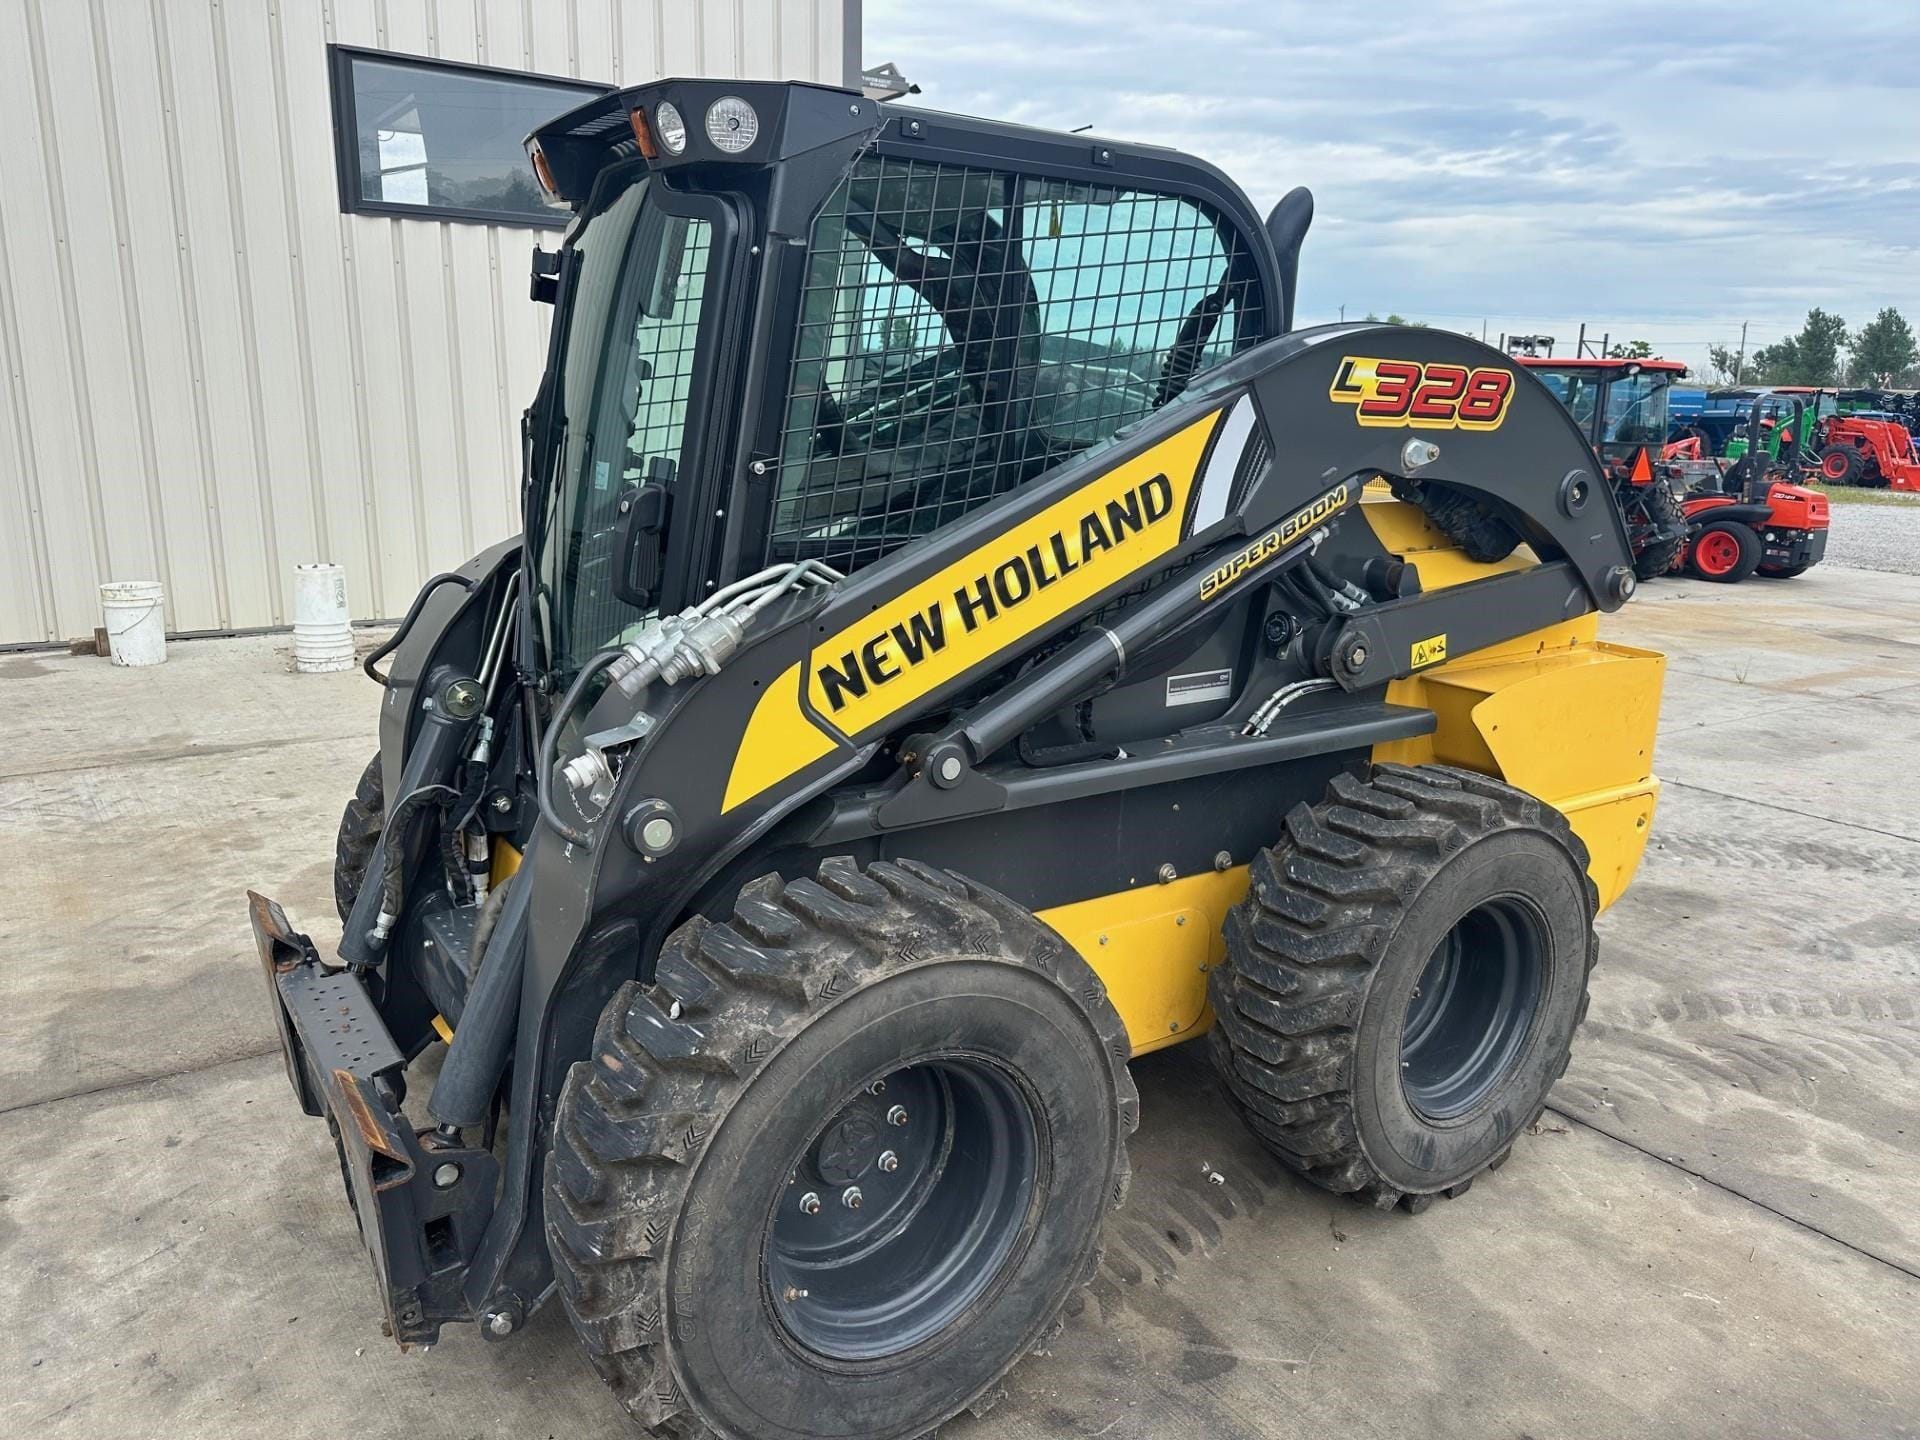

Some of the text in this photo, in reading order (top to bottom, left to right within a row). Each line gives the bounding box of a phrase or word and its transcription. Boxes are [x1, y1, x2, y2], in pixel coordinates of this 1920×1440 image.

[817, 472, 1175, 713] NEW HOLLAND
[1200, 484, 1348, 600] SUPER BOOM
[674, 1190, 708, 1343] GALAXY
